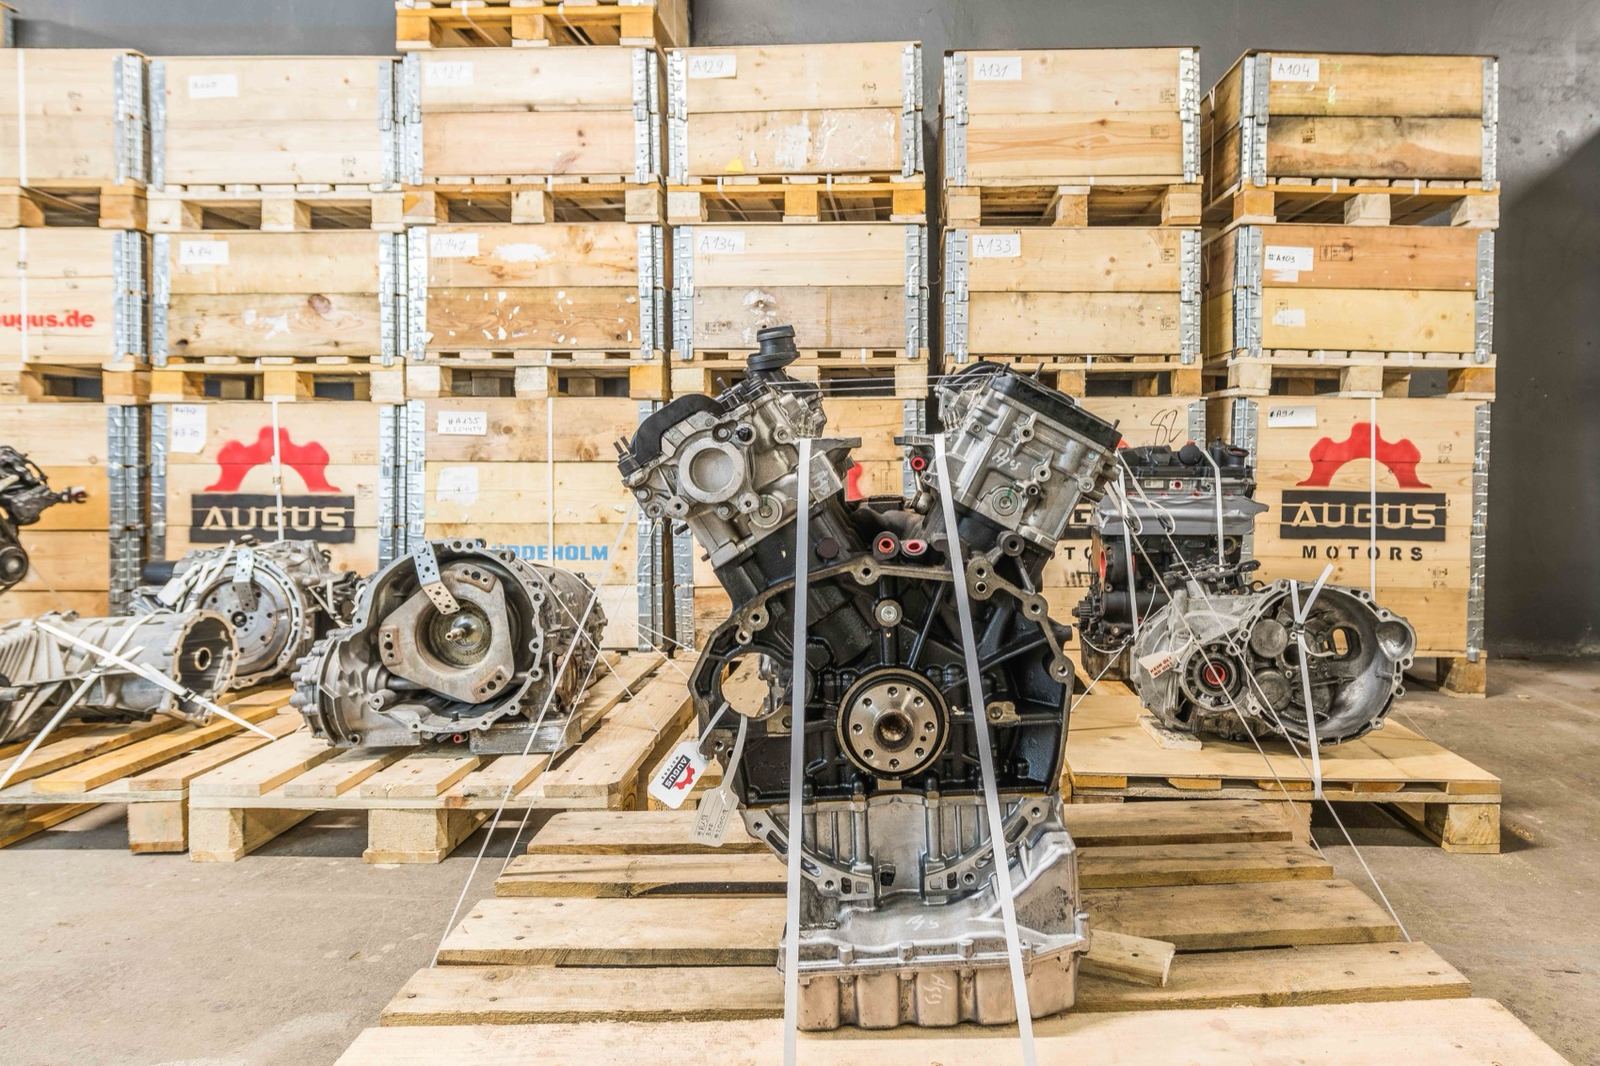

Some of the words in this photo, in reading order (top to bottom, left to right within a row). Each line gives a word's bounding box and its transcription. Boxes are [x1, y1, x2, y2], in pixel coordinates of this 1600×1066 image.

[1278, 62, 1310, 80] A104
[699, 235, 736, 252] A134
[975, 237, 1011, 255] A133
[201, 506, 345, 531] AUGUS
[1291, 501, 1436, 530] AUGUS
[490, 543, 609, 561] DDEHOLM
[1302, 544, 1423, 561] MOTORS
[664, 756, 690, 788] AUGUS
